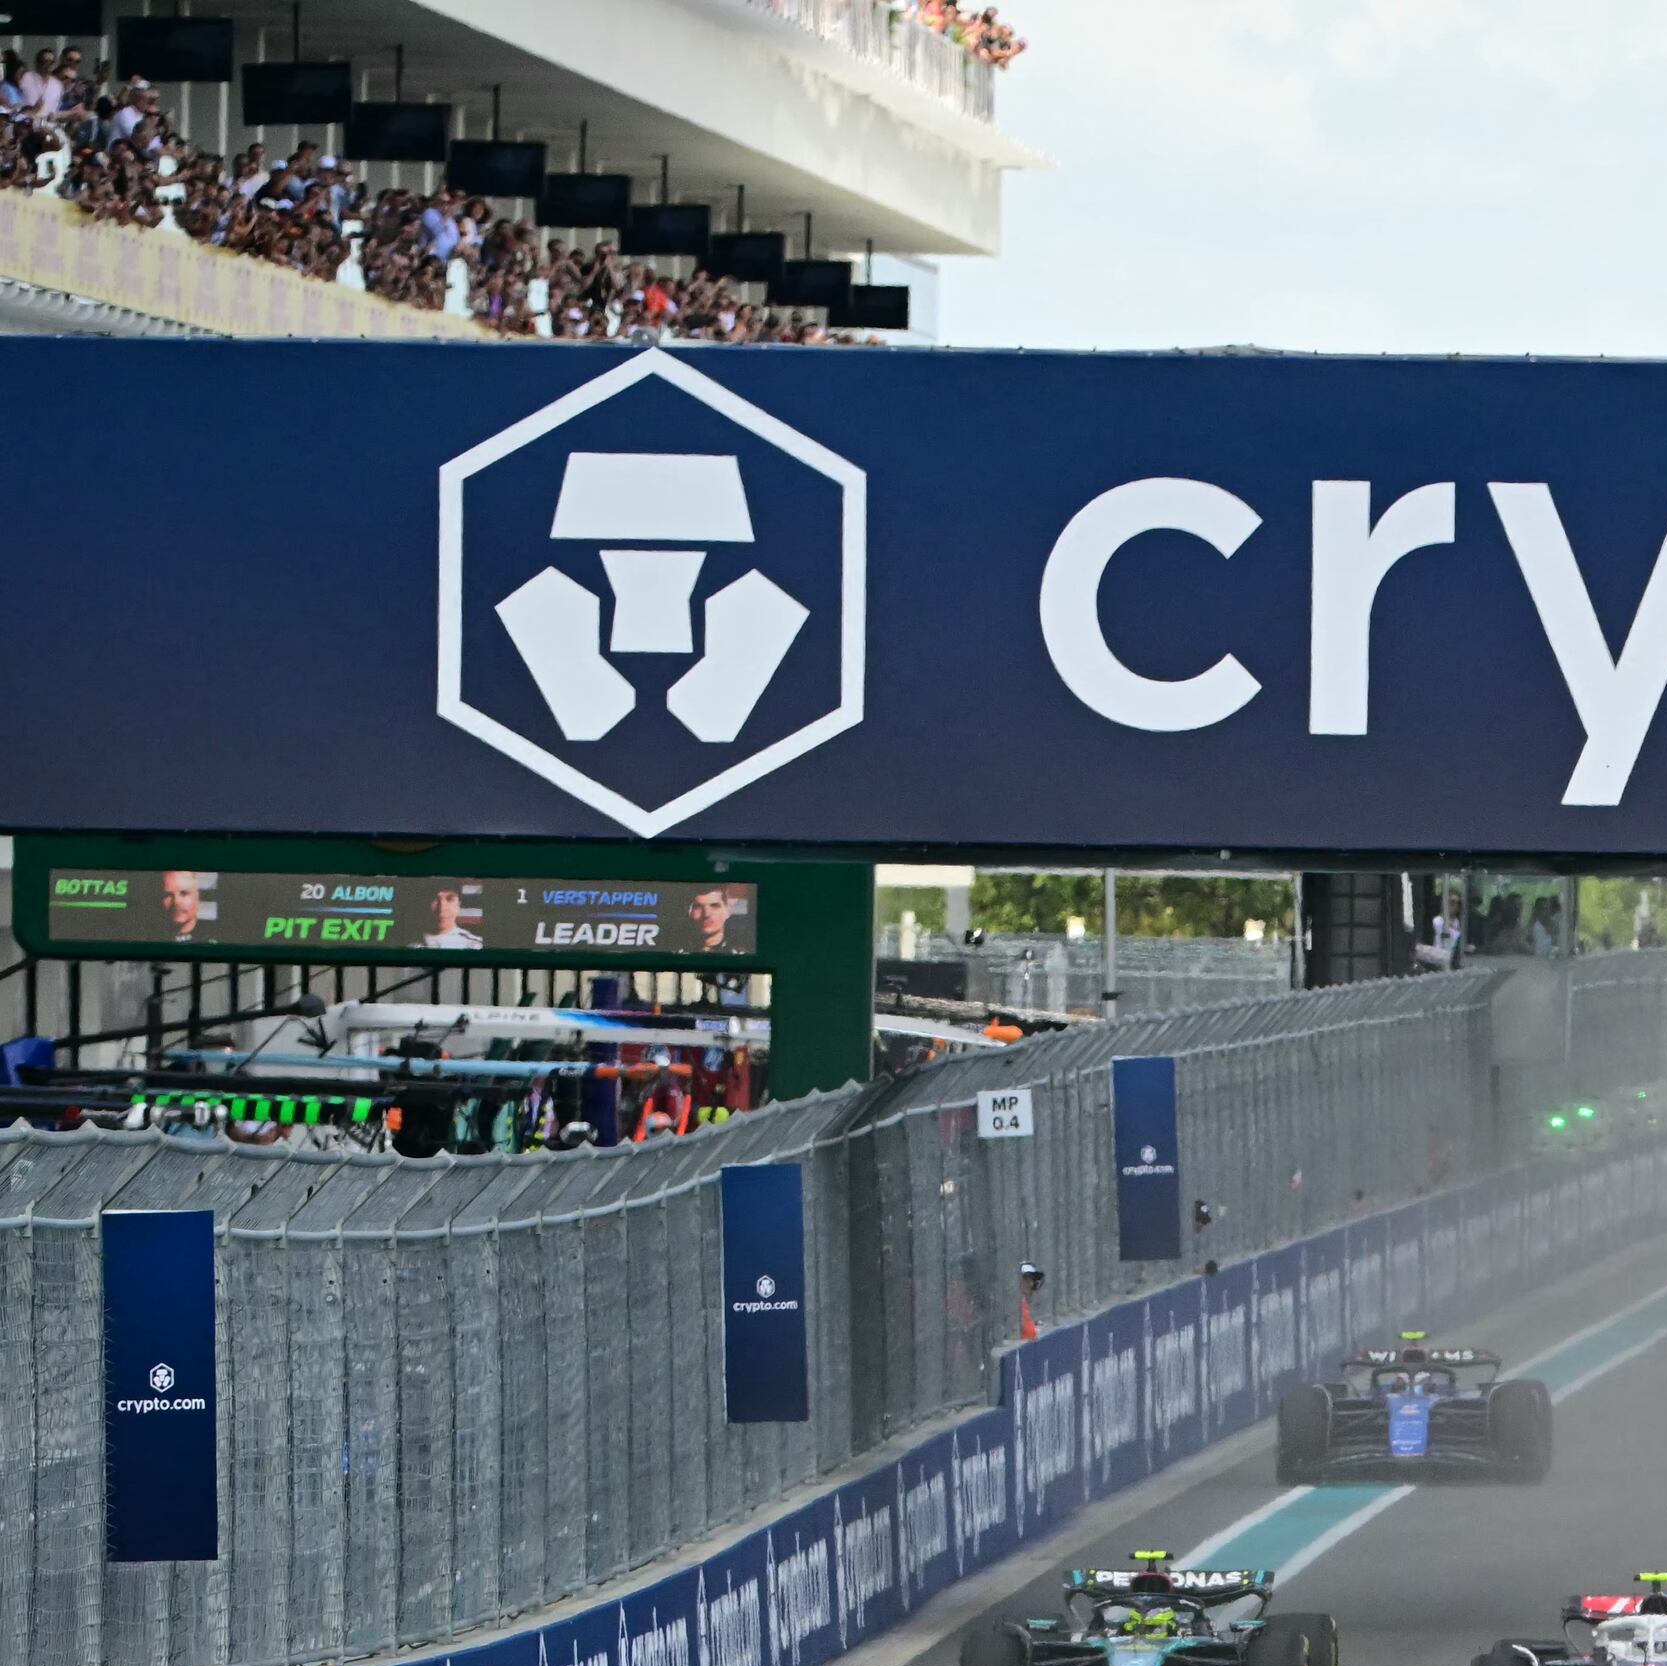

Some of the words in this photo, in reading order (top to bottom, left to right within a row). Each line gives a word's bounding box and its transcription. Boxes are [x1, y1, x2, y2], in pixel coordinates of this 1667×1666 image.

[55, 879, 128, 896] BOTTAS
[301, 884, 325, 900] 20
[331, 886, 394, 901] ALBON
[517, 888, 528, 904] 1
[543, 890, 657, 906] VERSTAPPEN
[265, 918, 317, 940] PIT
[321, 919, 394, 942] EXIT
[535, 922, 660, 946] LEADER
[992, 1098, 1018, 1111] MP
[992, 1115, 1019, 1130] 0.4
[732, 1298, 798, 1313] crypto.com
[117, 1395, 206, 1413] crypto.com
